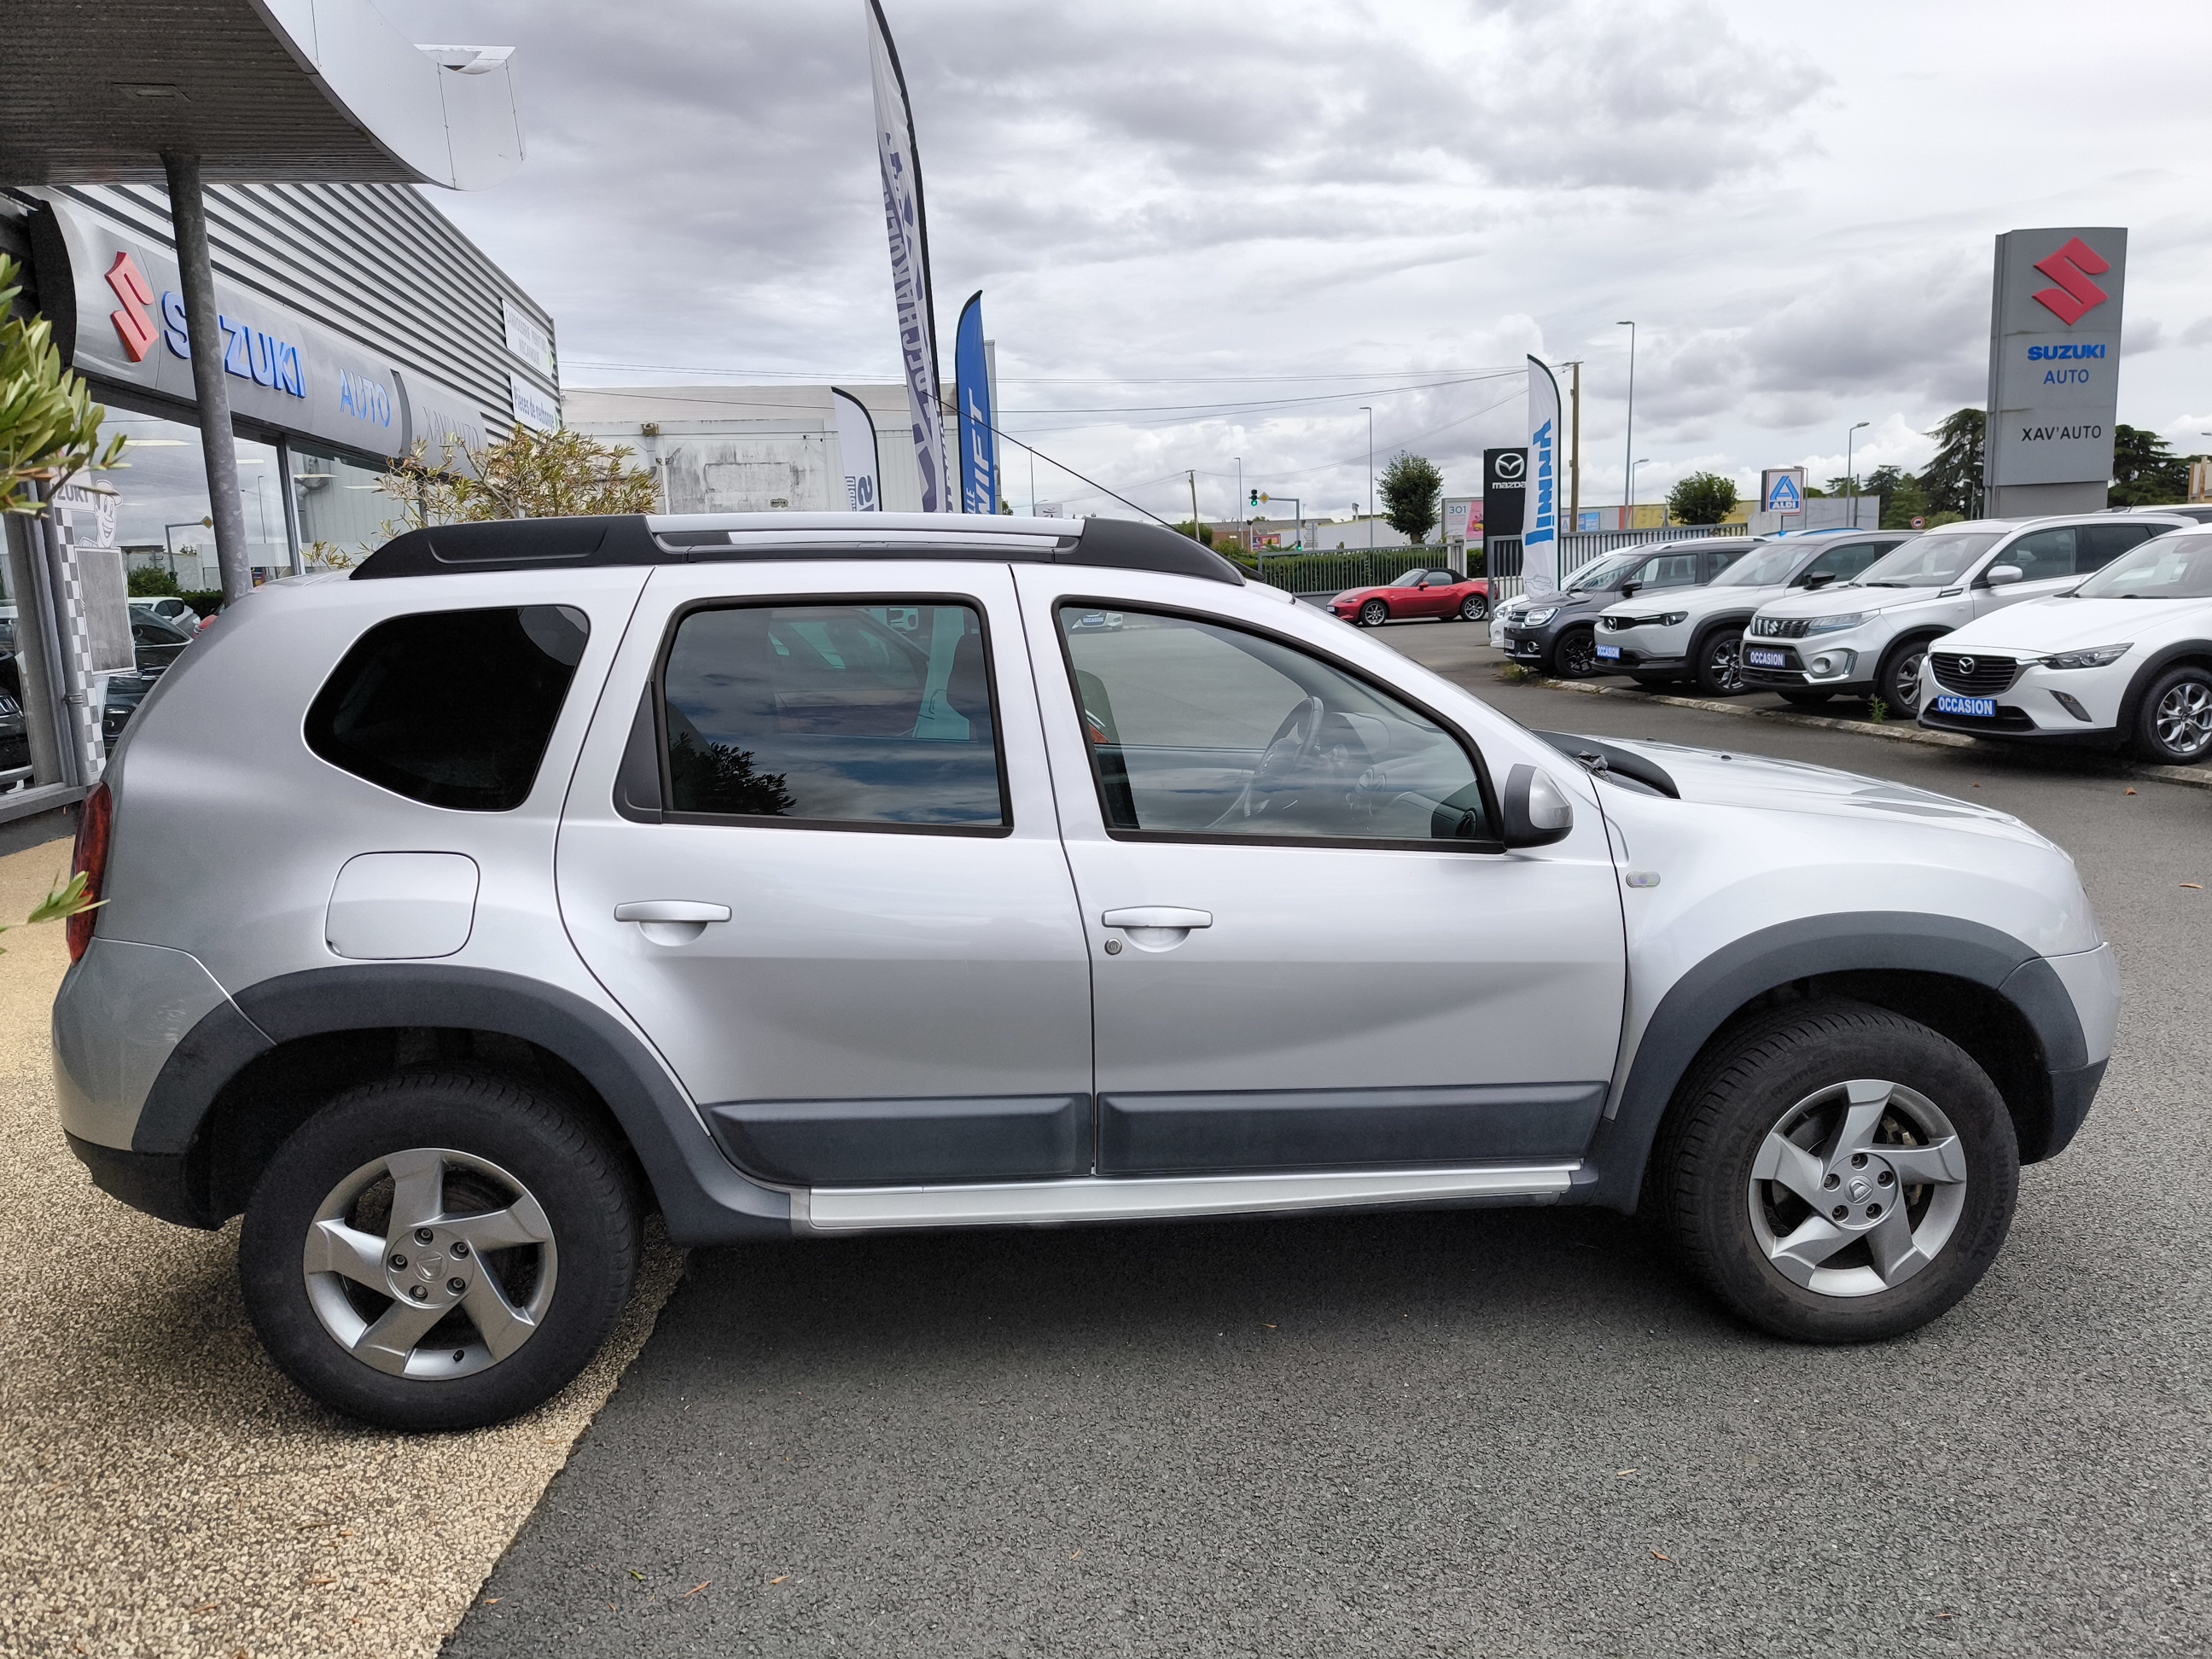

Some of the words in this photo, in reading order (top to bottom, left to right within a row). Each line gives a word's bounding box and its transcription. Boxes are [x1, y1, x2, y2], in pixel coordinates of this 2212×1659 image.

[162, 290, 306, 399] SZUKI
[340, 368, 391, 428] AUTO
[2027, 345, 2105, 361] SUZUKI
[2043, 369, 2090, 384] AUTO
[529, 393, 536, 419] de
[2021, 426, 2101, 441] XAV'AUTO
[969, 387, 991, 514] WIFT
[1597, 645, 1620, 658] OCCASION
[1749, 651, 1784, 666] OCCASION
[1938, 696, 1993, 715] OCCASION
